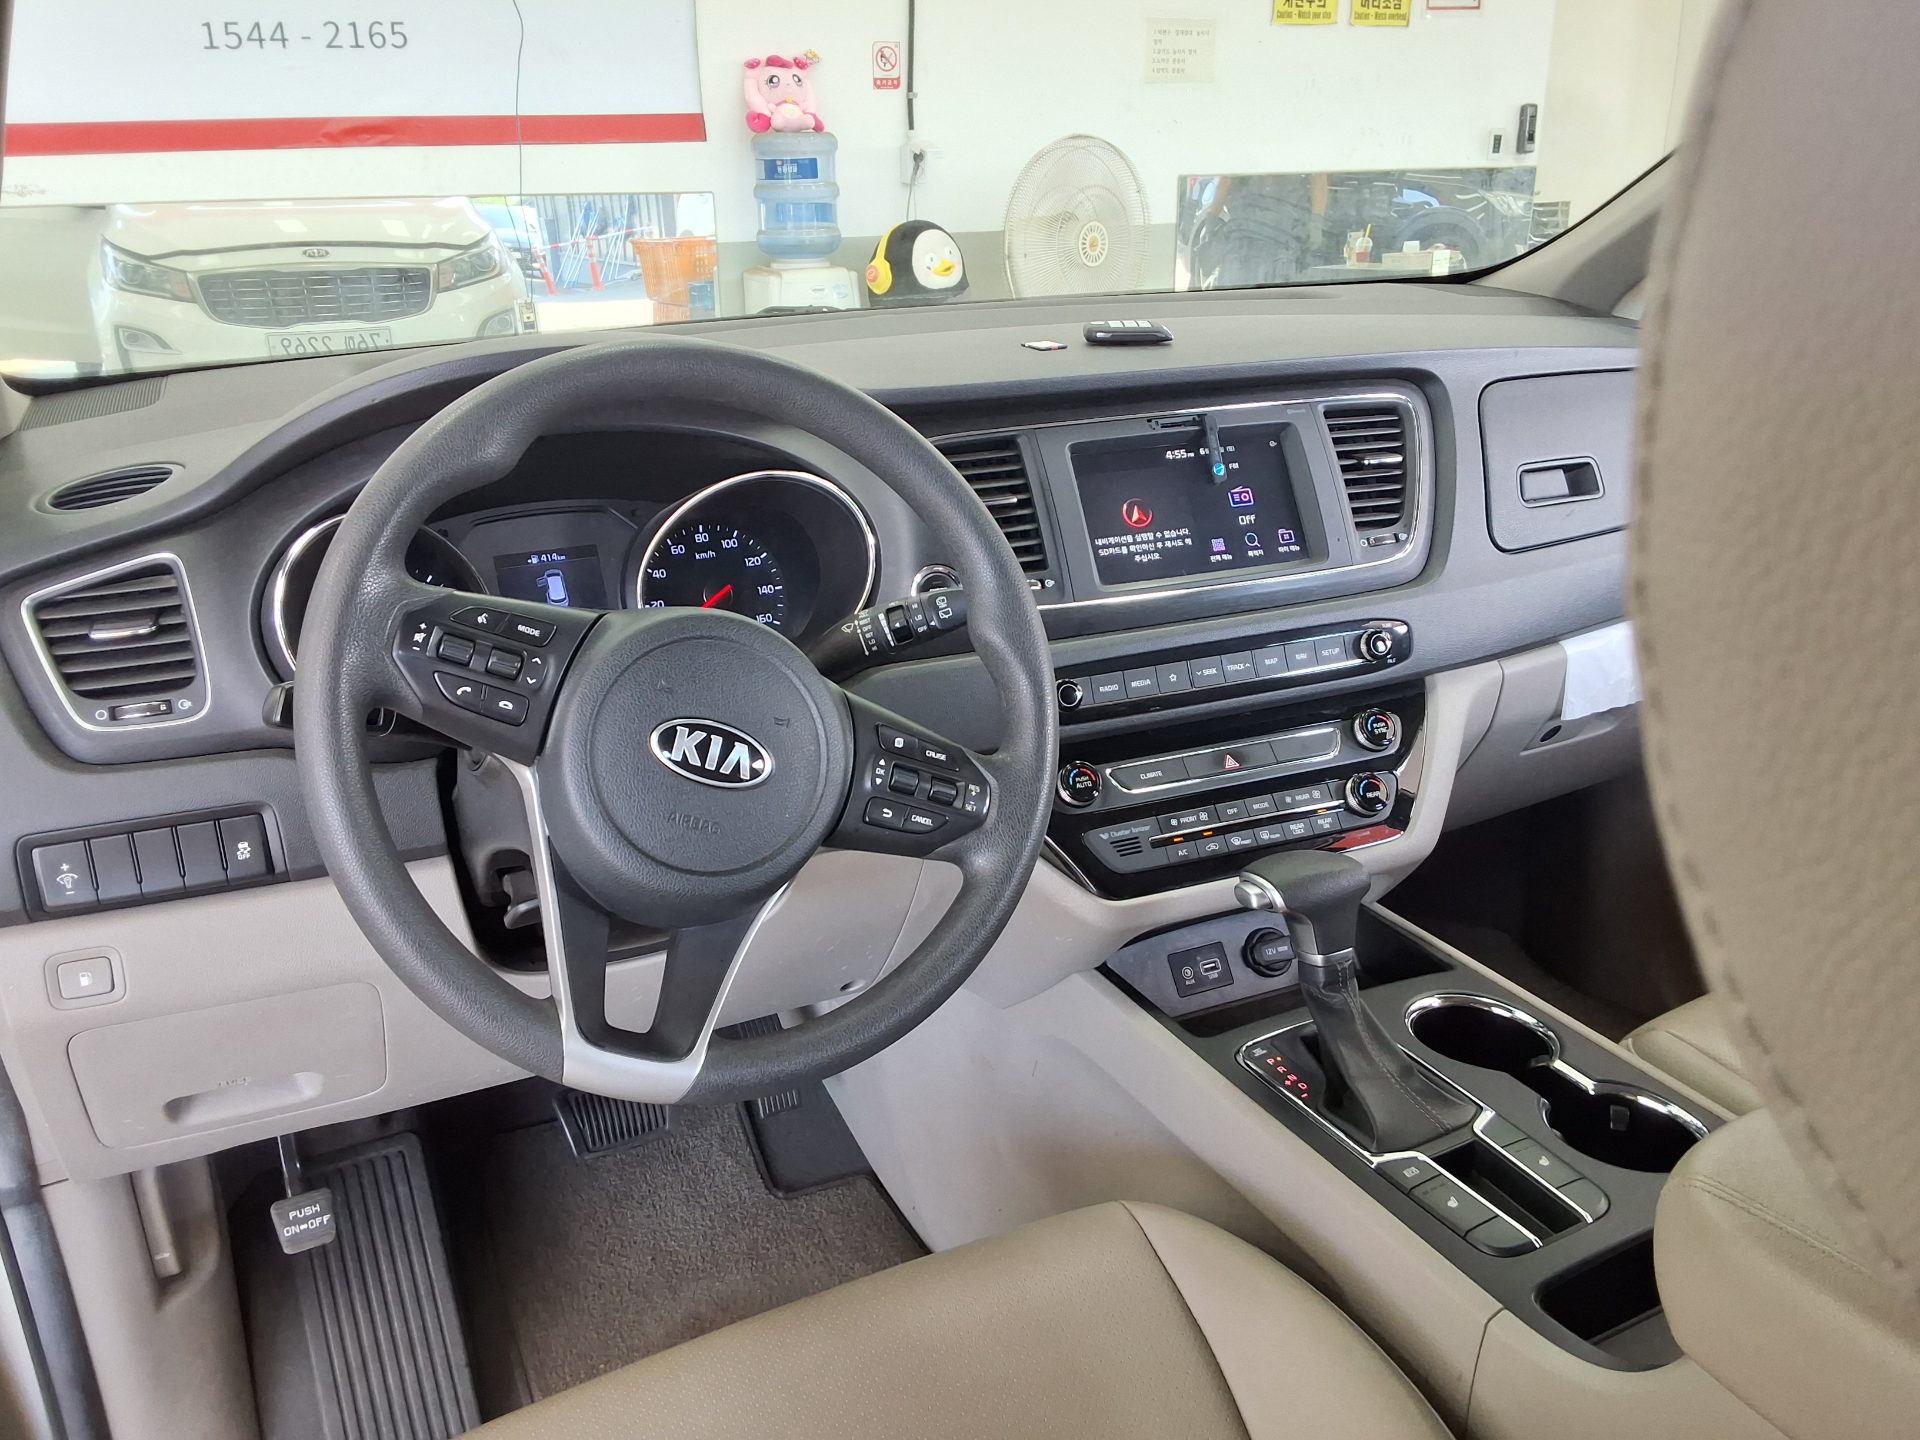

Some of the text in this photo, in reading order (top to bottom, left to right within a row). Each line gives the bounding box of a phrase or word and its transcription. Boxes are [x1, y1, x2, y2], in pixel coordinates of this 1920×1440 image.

[201, 21, 288, 50] 1544
[322, 20, 408, 49] 2165
[695, 533, 709, 543] 80
[1094, 534, 1134, 545] 내비게이션을
[1134, 532, 1154, 541] 실행할
[721, 538, 738, 549] 100
[670, 545, 685, 555] 60
[695, 550, 716, 560] km/h
[1098, 546, 1128, 556] SD카드를
[744, 556, 762, 567] 120
[652, 568, 667, 579] 40
[757, 584, 775, 595] 140
[651, 600, 665, 608] 20
[756, 613, 773, 624] 160
[517, 624, 541, 637] MODE
[1321, 647, 1340, 657] SETUP
[1264, 657, 1278, 665] MAP
[1202, 667, 1218, 676] SEEK
[1226, 663, 1245, 672] TRACK
[1099, 683, 1119, 693] RADIO
[1131, 679, 1151, 688] MEDIA
[670, 724, 751, 781] KIA
[925, 749, 947, 761] CRUISE
[875, 767, 886, 776] OK
[1139, 770, 1163, 780] CLIMATE
[1075, 775, 1089, 783] PUSH
[968, 783, 980, 793] RES
[1076, 780, 1092, 789] AUTO
[1295, 793, 1310, 801] REAR
[1366, 790, 1380, 799] REAR
[965, 803, 977, 812] SET
[1252, 801, 1269, 810] MODE
[1226, 807, 1239, 815] OFF
[911, 814, 933, 826] CANCEL
[1180, 815, 1197, 824] FRONT
[1290, 822, 1304, 830] REAR
[1110, 829, 1131, 838] Cluster
[1178, 848, 1188, 856] A/C
[1265, 947, 1276, 956] 12V
[289, 1203, 320, 1220] PUSH
